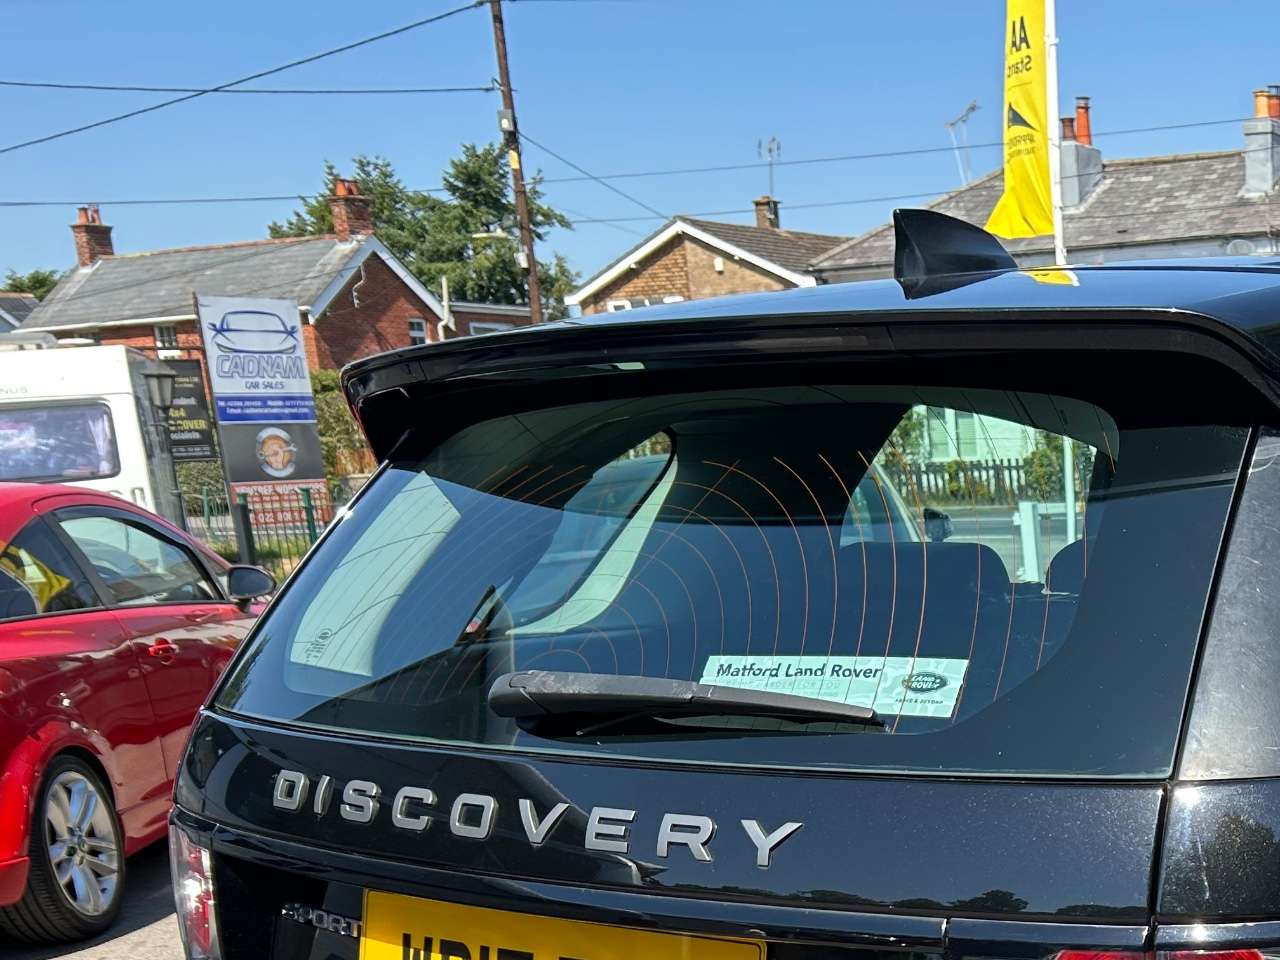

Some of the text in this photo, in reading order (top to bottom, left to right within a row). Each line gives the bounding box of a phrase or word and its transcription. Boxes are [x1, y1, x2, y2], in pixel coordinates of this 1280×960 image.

[216, 354, 306, 379] CADNAM
[244, 380, 285, 390] CAR SALES
[715, 662, 883, 680] Matford Land Rover
[273, 769, 803, 867] DISCOVERY
